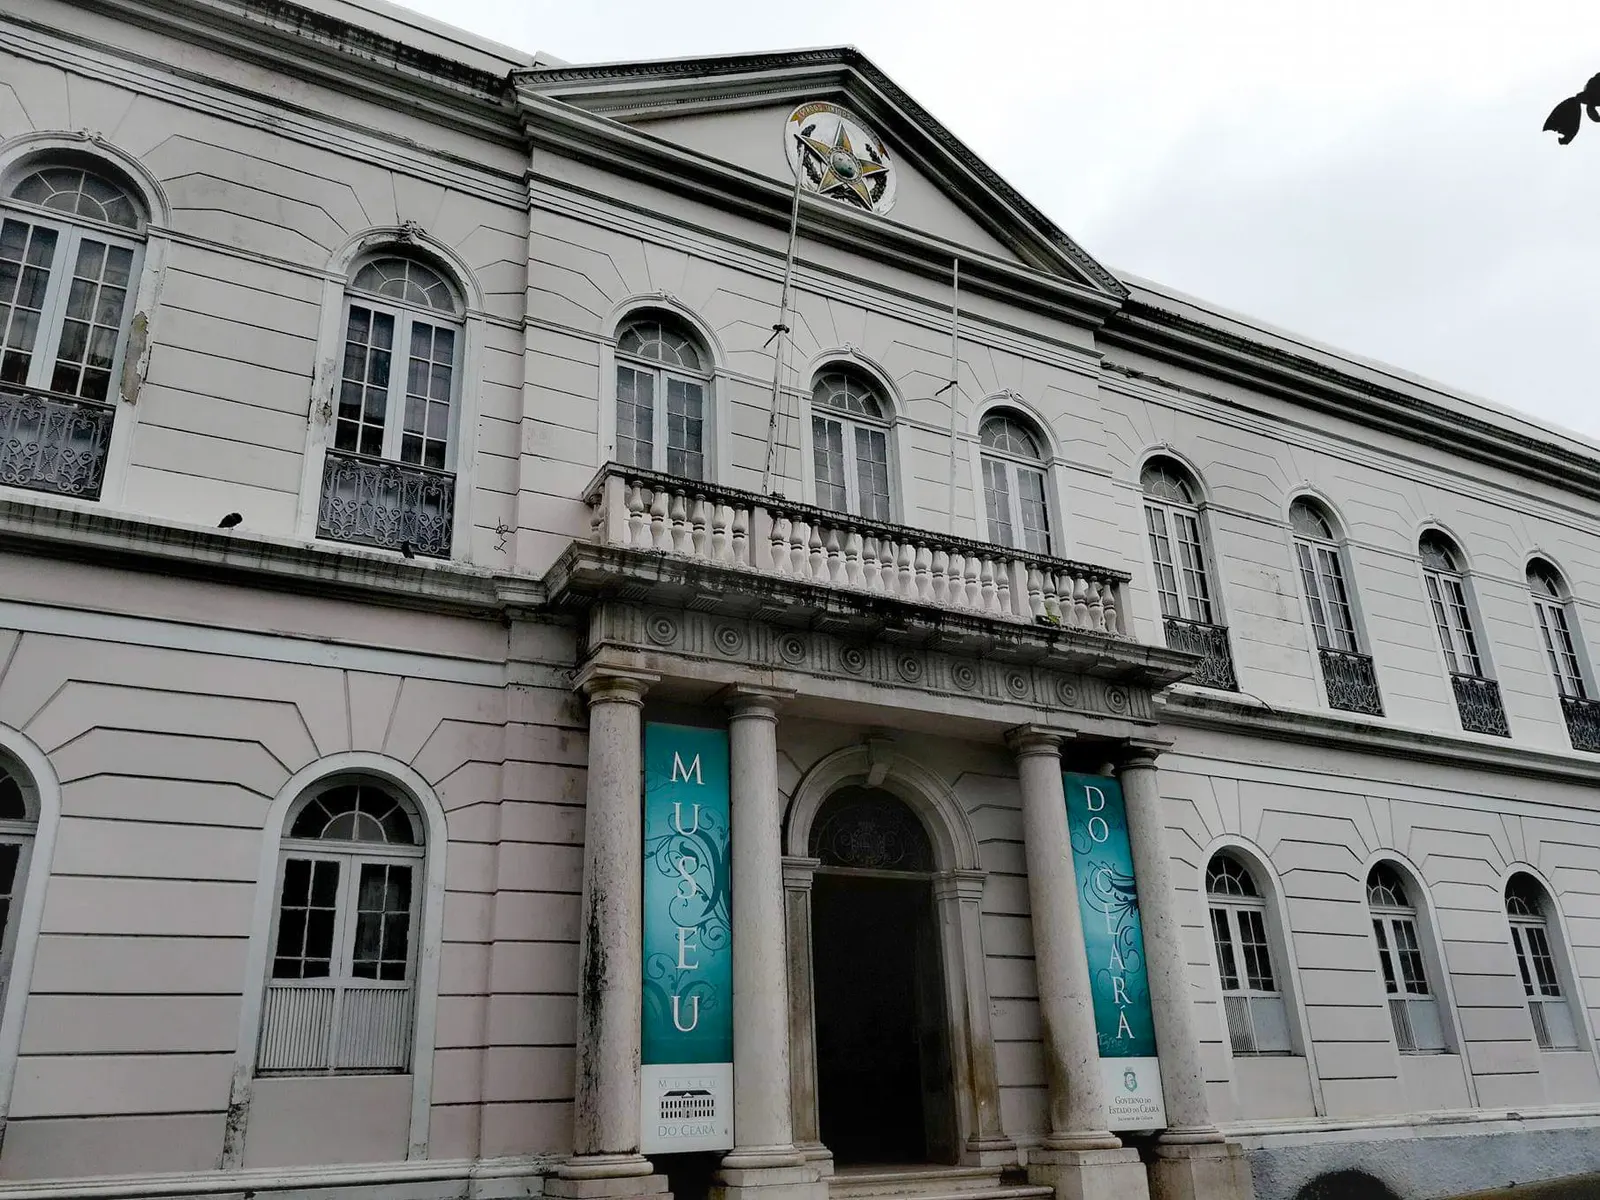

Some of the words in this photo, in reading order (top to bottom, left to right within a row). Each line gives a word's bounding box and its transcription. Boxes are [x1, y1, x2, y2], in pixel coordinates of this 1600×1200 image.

[670, 751, 705, 1032] MUSEU
[1083, 785, 1109, 843] DO
[1097, 869, 1135, 1039] CEARÁ
[658, 1080, 715, 1088] MUSEU
[658, 1126, 677, 1136] DO
